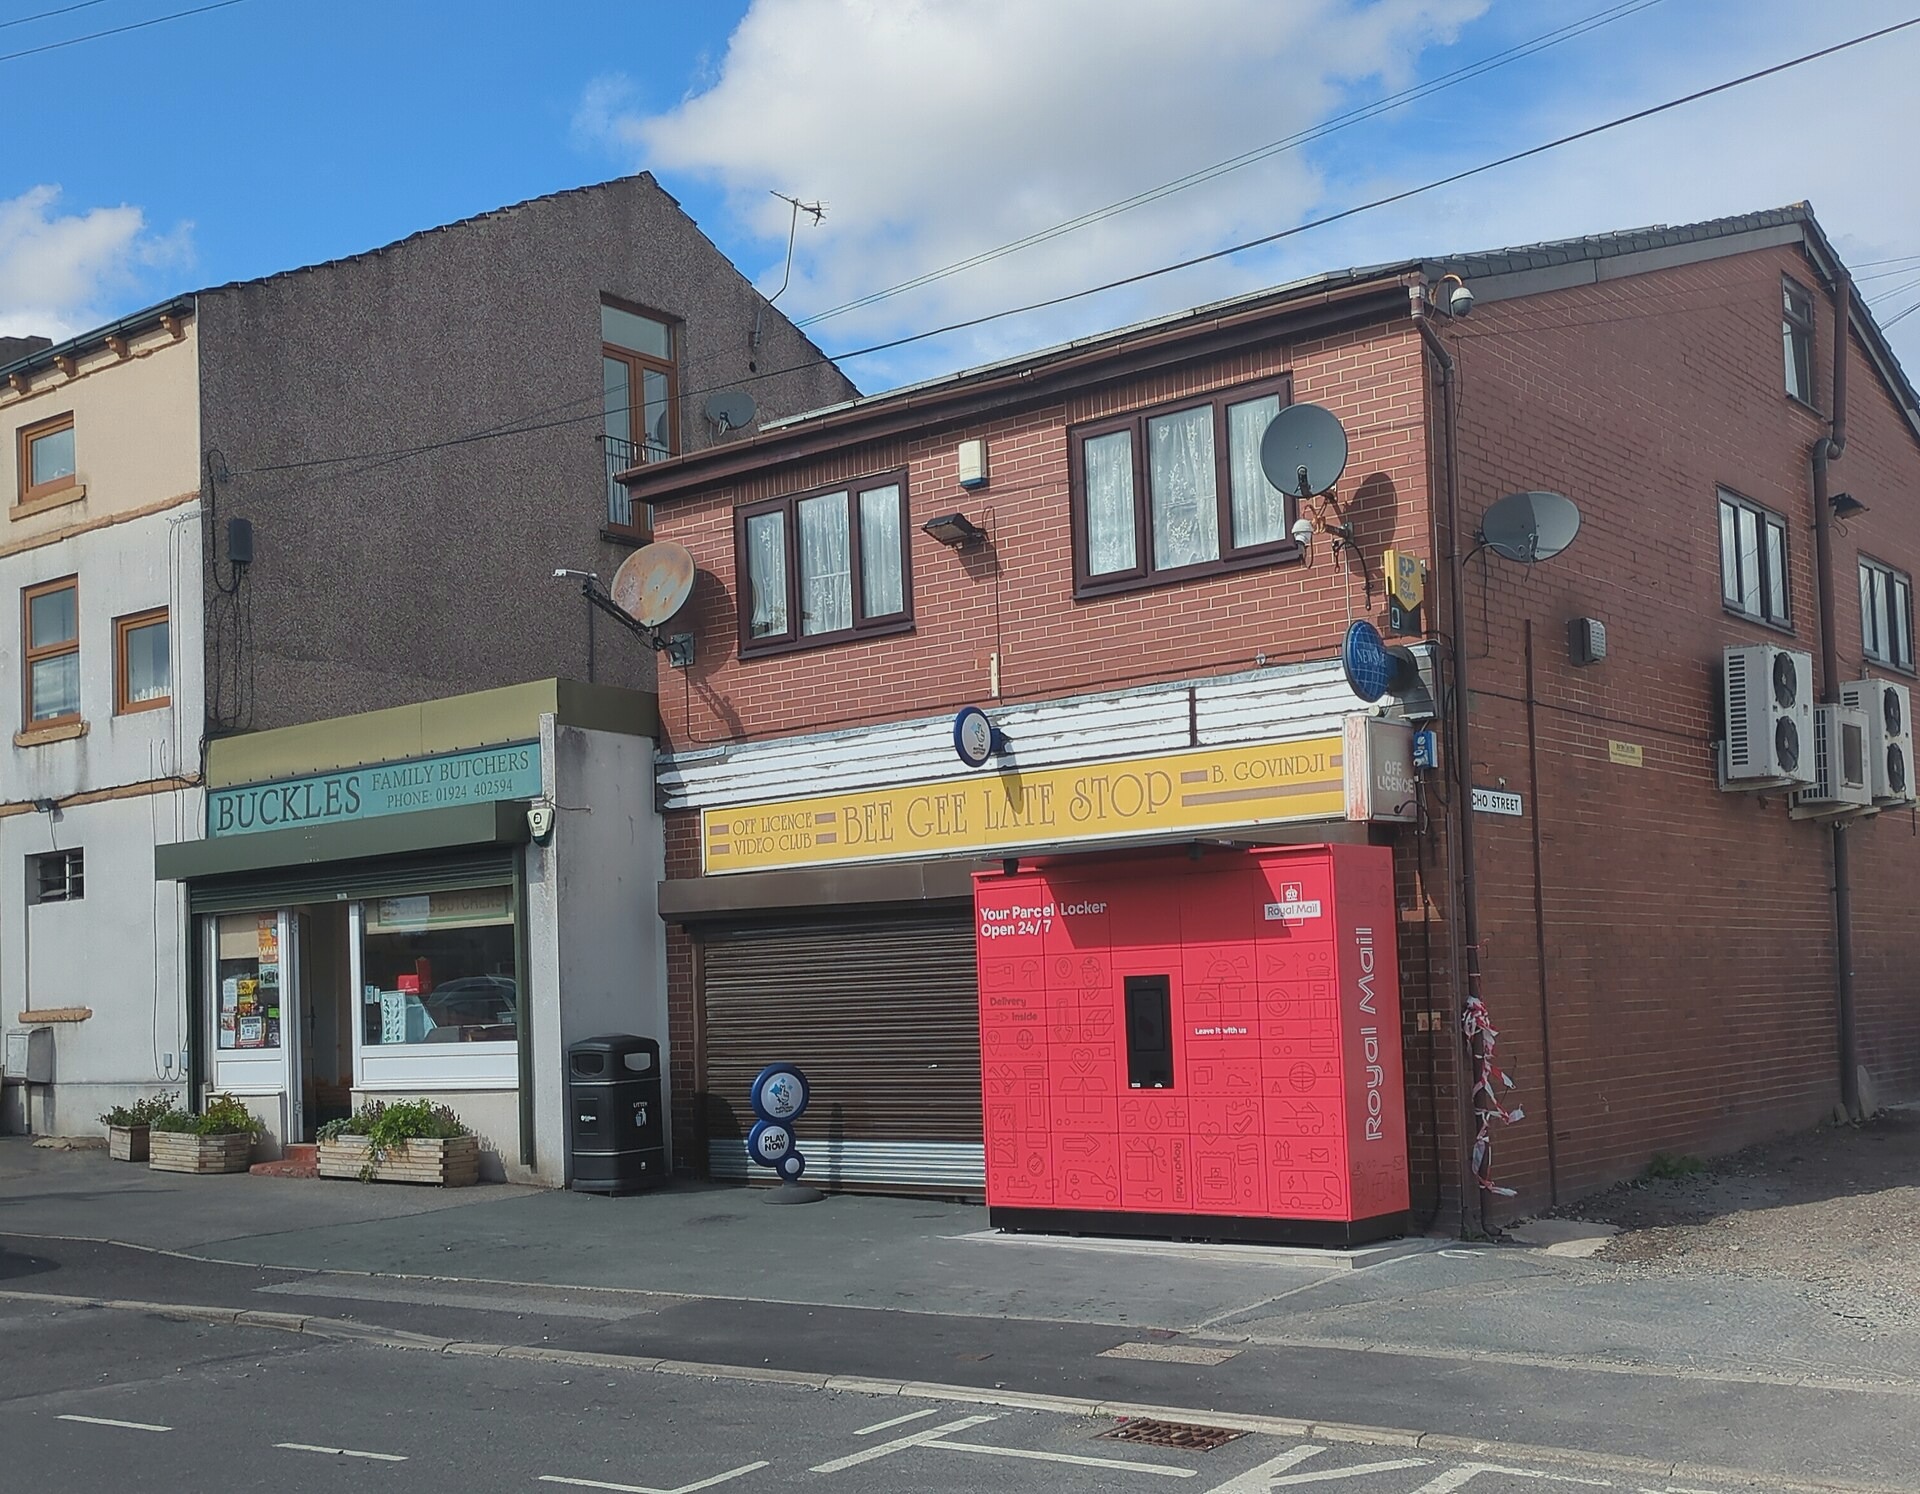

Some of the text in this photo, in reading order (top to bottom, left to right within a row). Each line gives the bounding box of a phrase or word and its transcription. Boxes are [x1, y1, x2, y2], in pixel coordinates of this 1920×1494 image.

[371, 750, 529, 792] FAMILY BUTCHERS
[1211, 753, 1325, 784] B. GOVINDJI
[1384, 760, 1402, 775] OFF
[387, 779, 513, 809] PHONE: 01924 402594
[1377, 775, 1415, 794] LICENCE
[216, 776, 361, 832] BUCKLES
[843, 771, 1172, 844] BEE GEE LATE STOP
[1492, 795, 1519, 811] STREET
[732, 812, 812, 836] OFF LICENCE
[733, 832, 812, 855] VIDEO CLUB
[980, 901, 1107, 921] Your Parcel Locker
[1267, 903, 1318, 917] Royal Mail
[981, 920, 1052, 939] Open 24/7
[990, 997, 1027, 1007] Delivery
[1222, 1026, 1238, 1034] with
[1355, 928, 1384, 1140] Royal Mail
[764, 1133, 785, 1144] PLAY
[764, 1142, 785, 1152] NOW
[1173, 1142, 1184, 1199] Royal Mail
